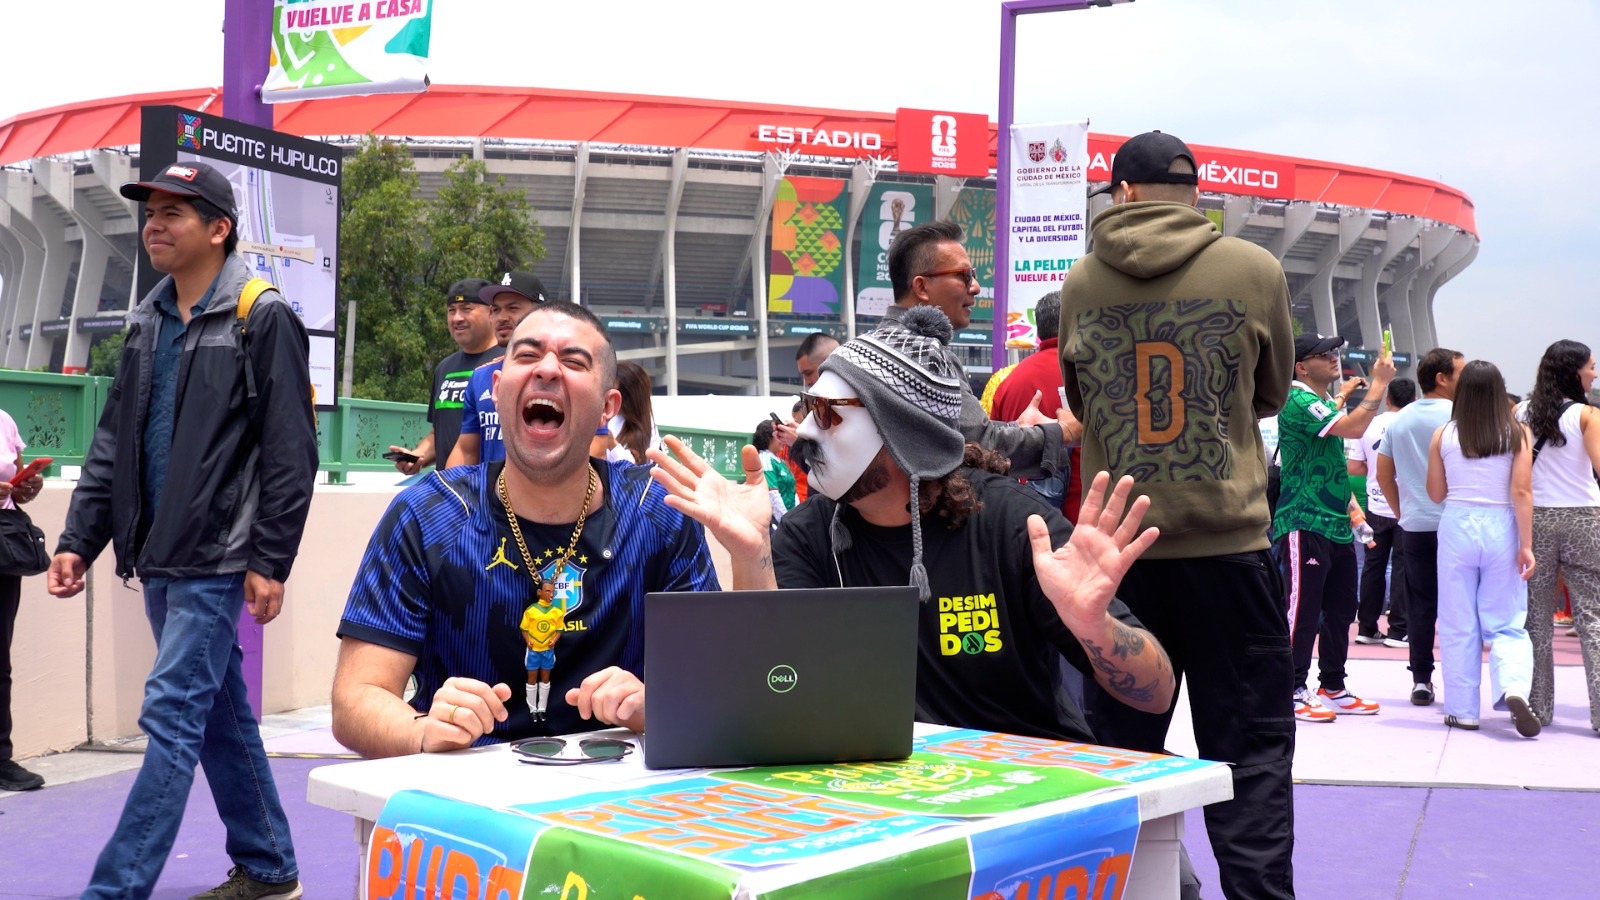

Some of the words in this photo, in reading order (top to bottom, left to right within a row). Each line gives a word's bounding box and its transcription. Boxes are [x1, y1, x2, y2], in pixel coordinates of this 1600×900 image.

[287, 5, 354, 28] VUELVE
[358, 3, 370, 21] A
[376, 0, 421, 18] CASA
[758, 124, 881, 150] ESTADIO
[203, 128, 266, 160] PUENTE
[270, 144, 338, 177] HUIPULCO
[1016, 166, 1056, 174] GOBIERNO
[1058, 224, 1084, 232] FUTBOL
[1036, 234, 1078, 242] DIVERSIDAD
[1014, 260, 1030, 271] LA
[1034, 258, 1078, 270] PELOT
[1015, 274, 1048, 282] VUELVE
[1050, 273, 1056, 281] A
[938, 593, 996, 612] DESIM
[940, 608, 1000, 633] PEDI
